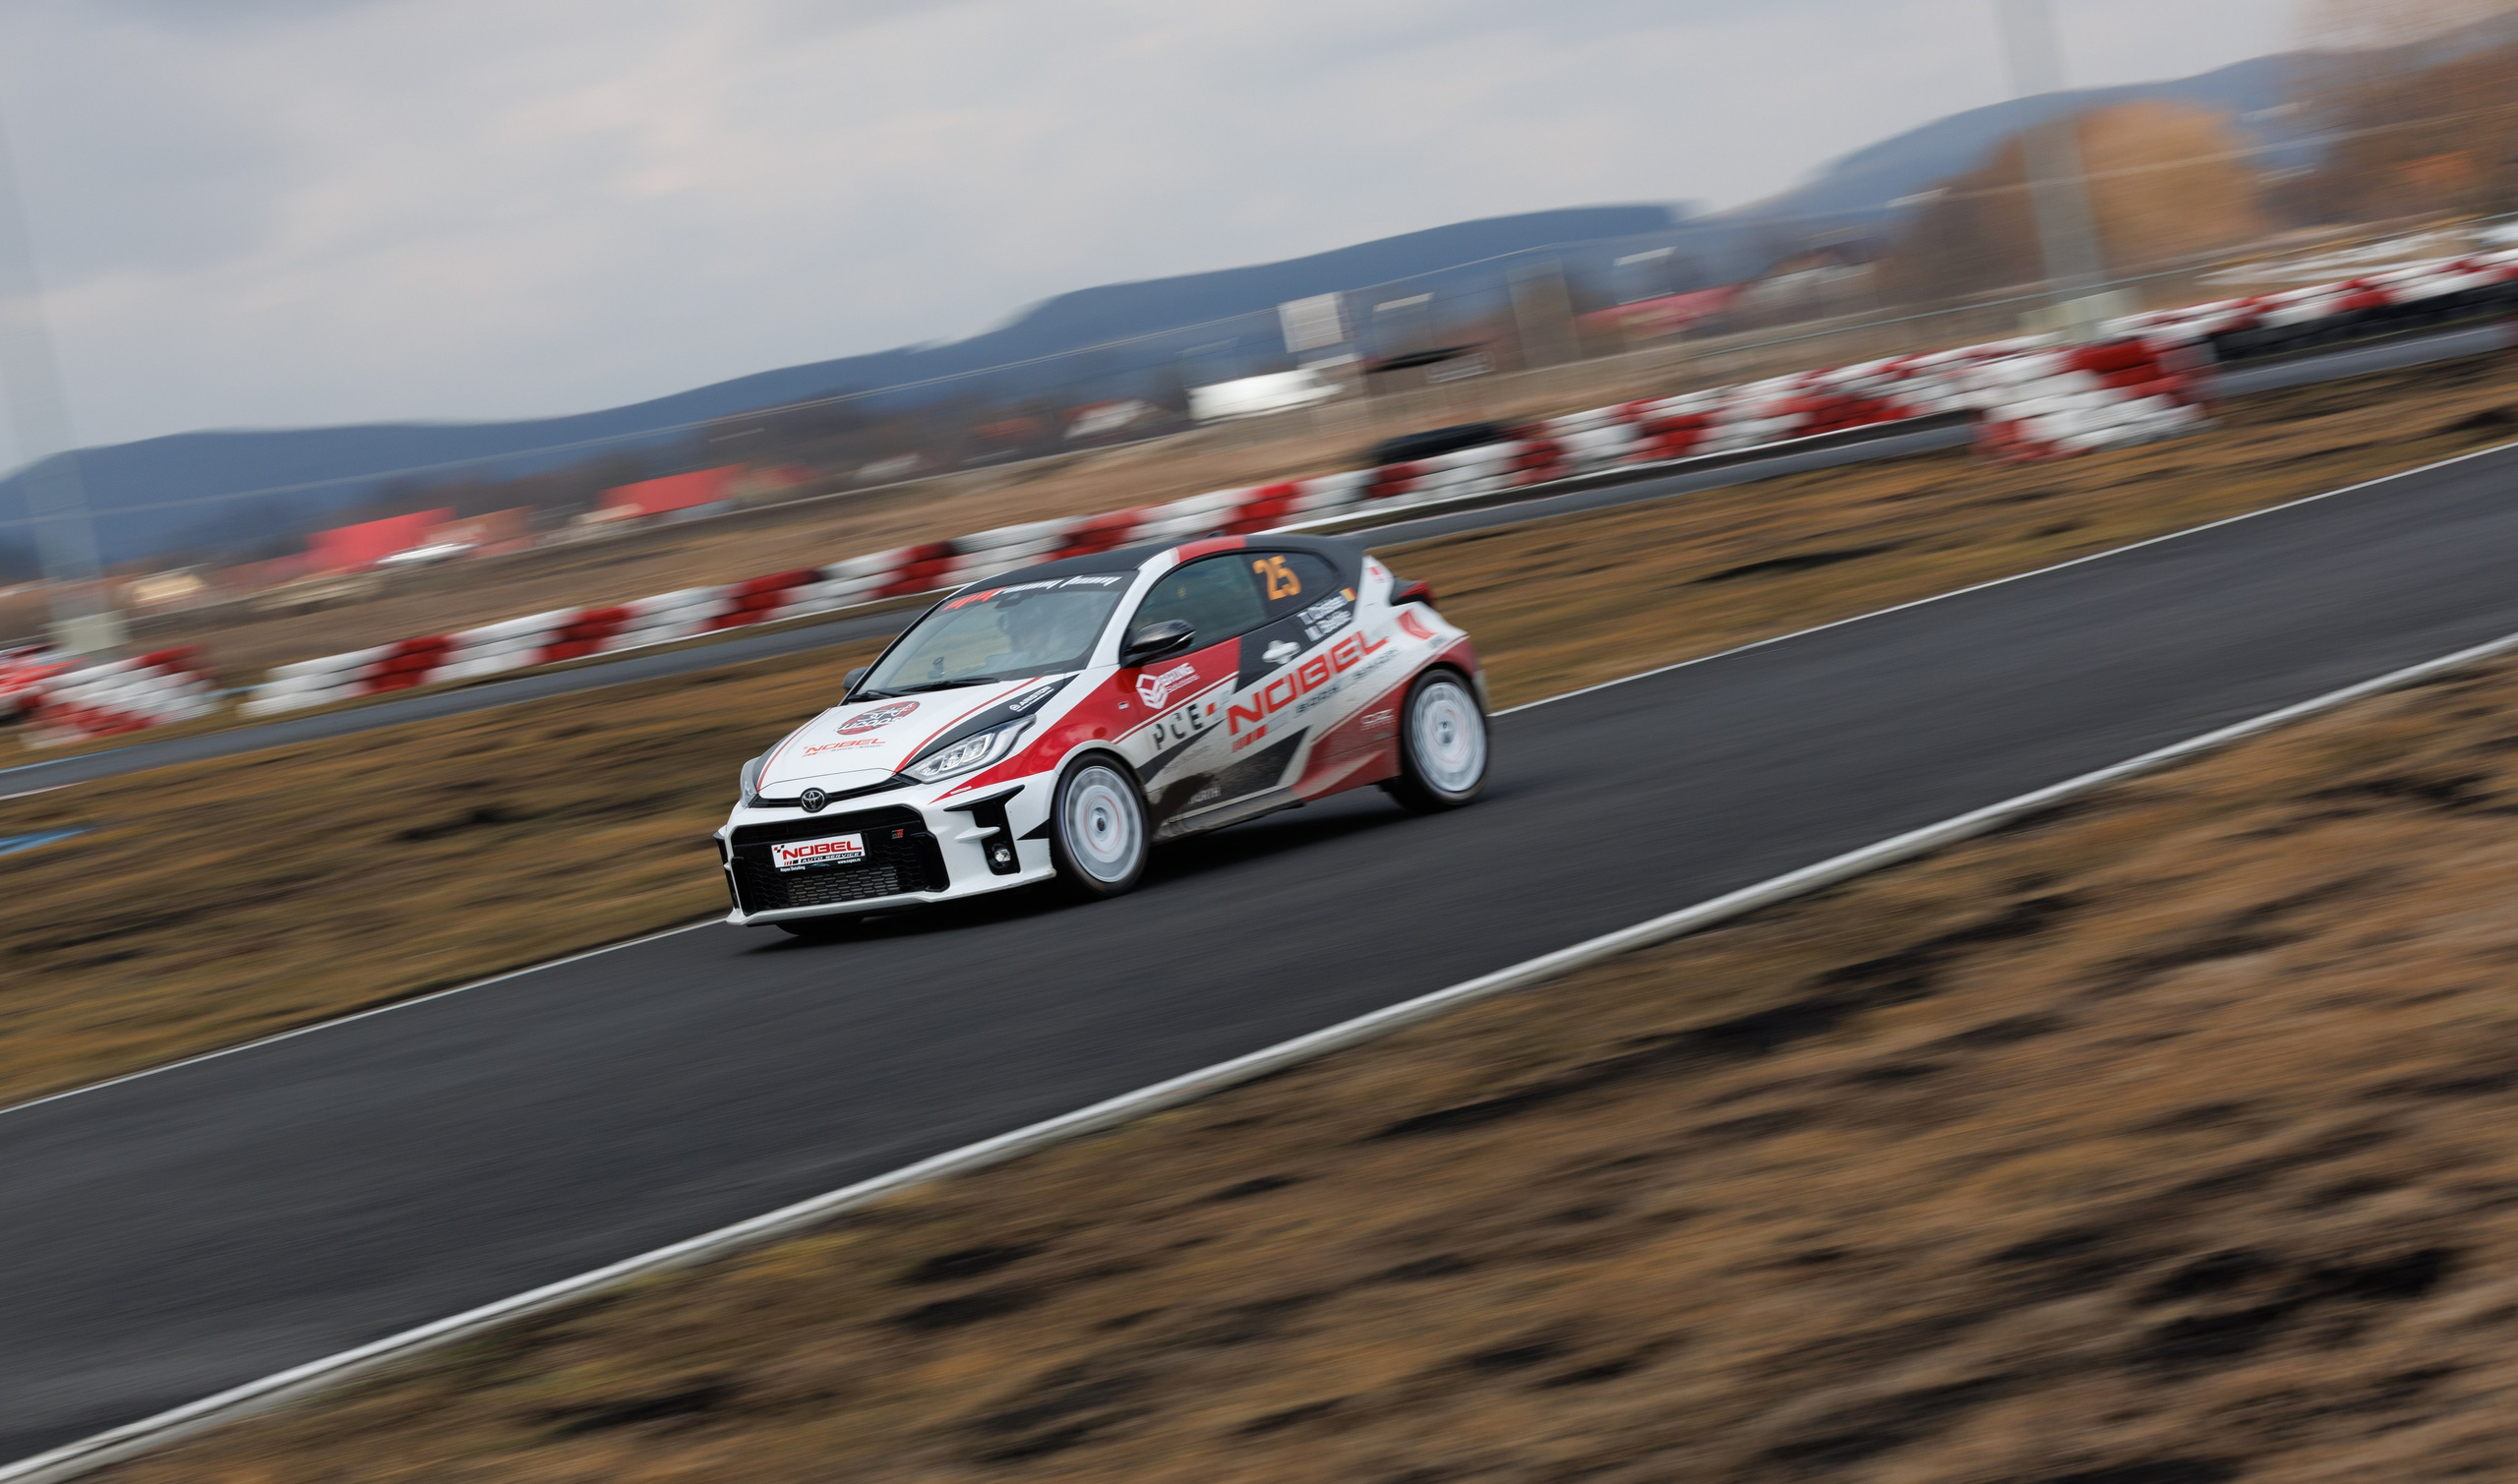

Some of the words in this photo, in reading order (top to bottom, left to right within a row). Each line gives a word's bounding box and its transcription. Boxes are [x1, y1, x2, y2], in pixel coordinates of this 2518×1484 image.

[1252, 555, 1302, 601] 25
[1227, 630, 1391, 736] NOBEL
[1152, 703, 1204, 751] PCE
[806, 738, 886, 754] NOBEL
[782, 840, 863, 861] NOBEL
[825, 852, 861, 861] SERVICE
